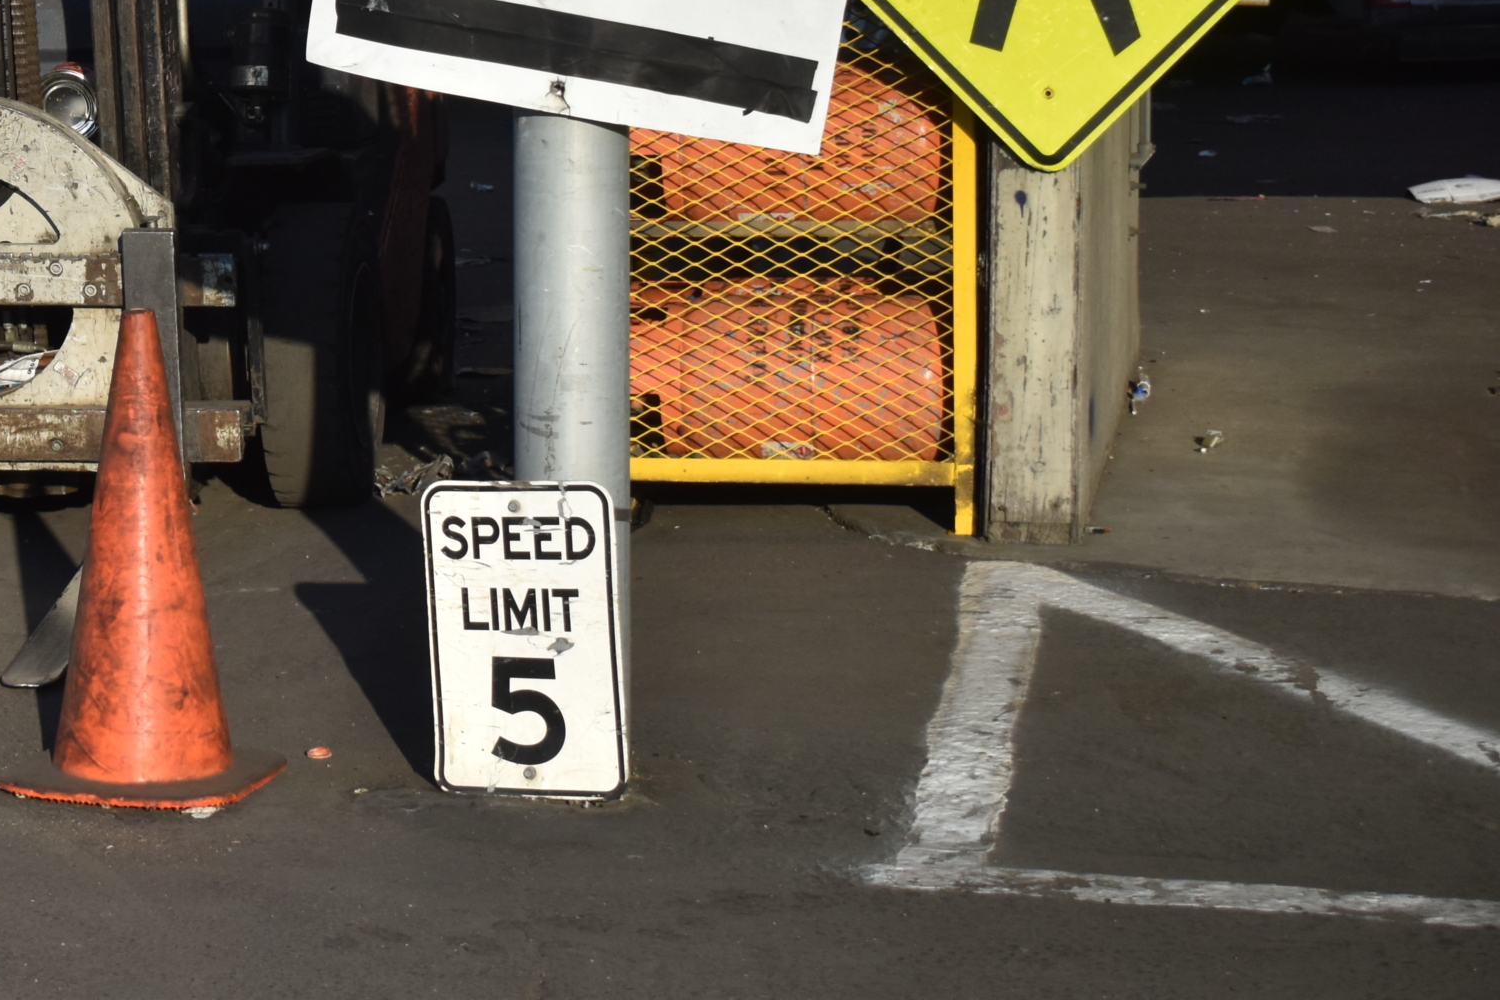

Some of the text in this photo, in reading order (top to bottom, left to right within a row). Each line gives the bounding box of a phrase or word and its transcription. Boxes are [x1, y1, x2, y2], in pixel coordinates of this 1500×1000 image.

[440, 516, 596, 560] SPEED
[460, 587, 579, 632] LIMIT
[491, 656, 566, 765] 5
